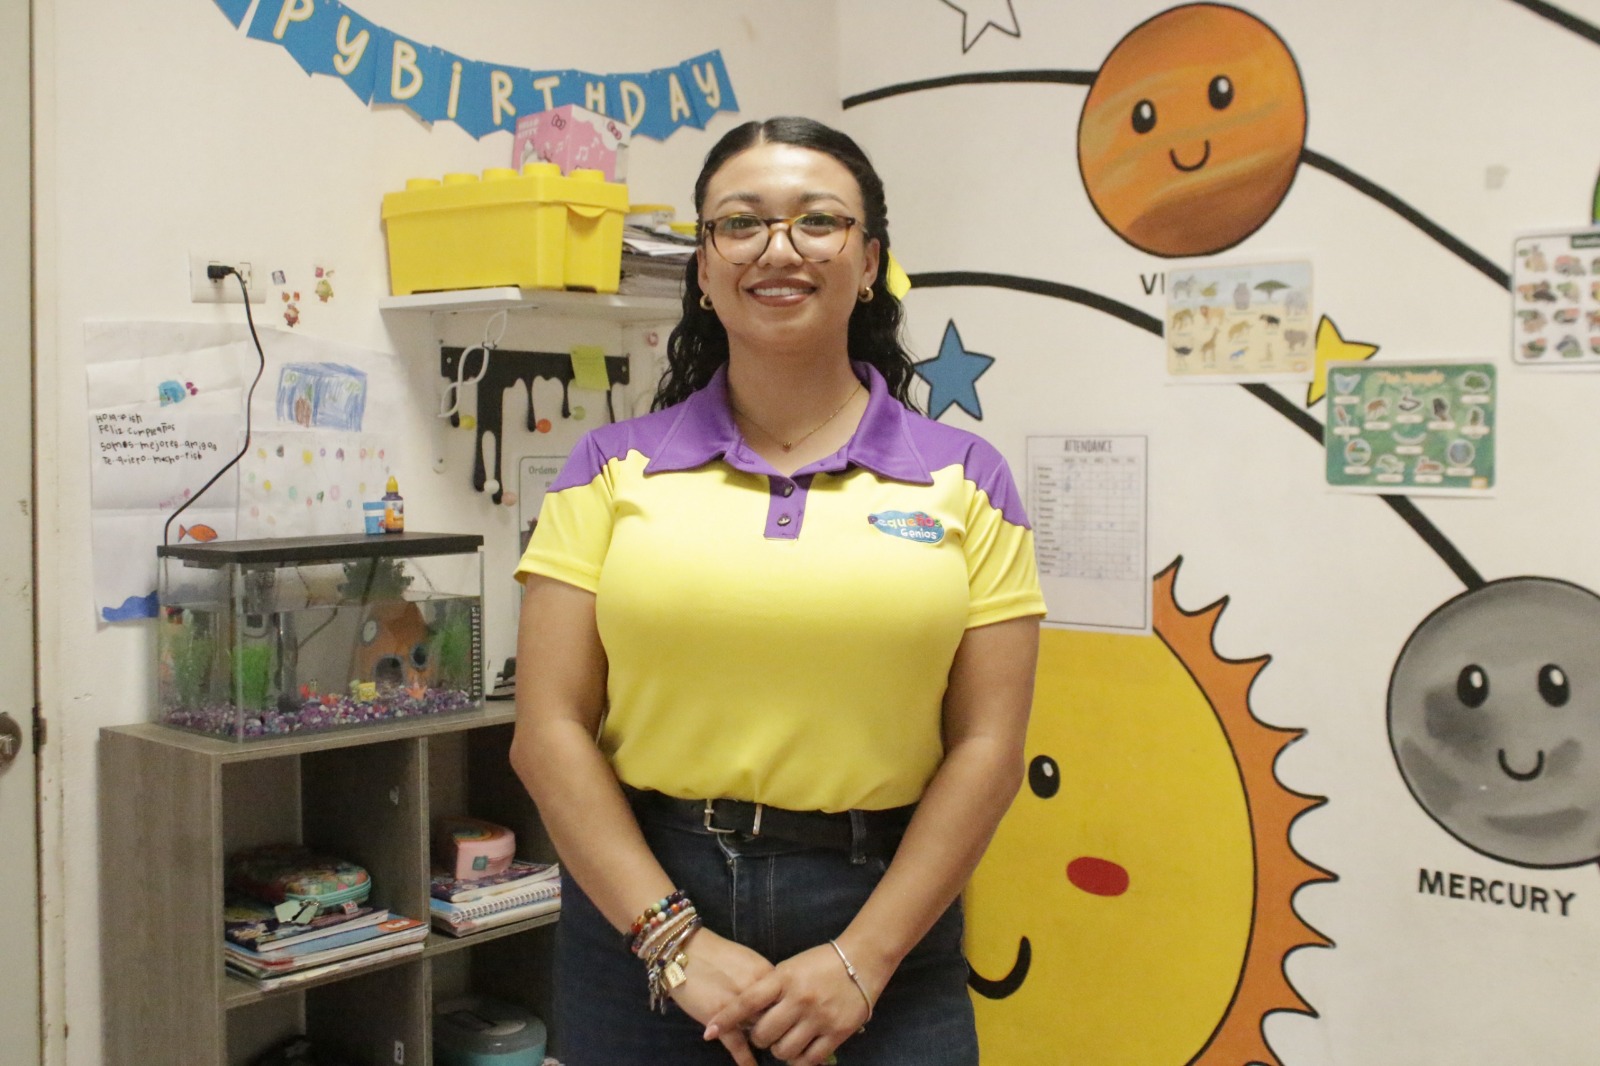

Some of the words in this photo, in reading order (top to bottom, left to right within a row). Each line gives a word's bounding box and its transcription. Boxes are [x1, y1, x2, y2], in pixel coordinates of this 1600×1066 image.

[1064, 439, 1113, 454] ATTENDANCE
[900, 527, 938, 540] Genios
[1418, 867, 1577, 917] MERCURY
